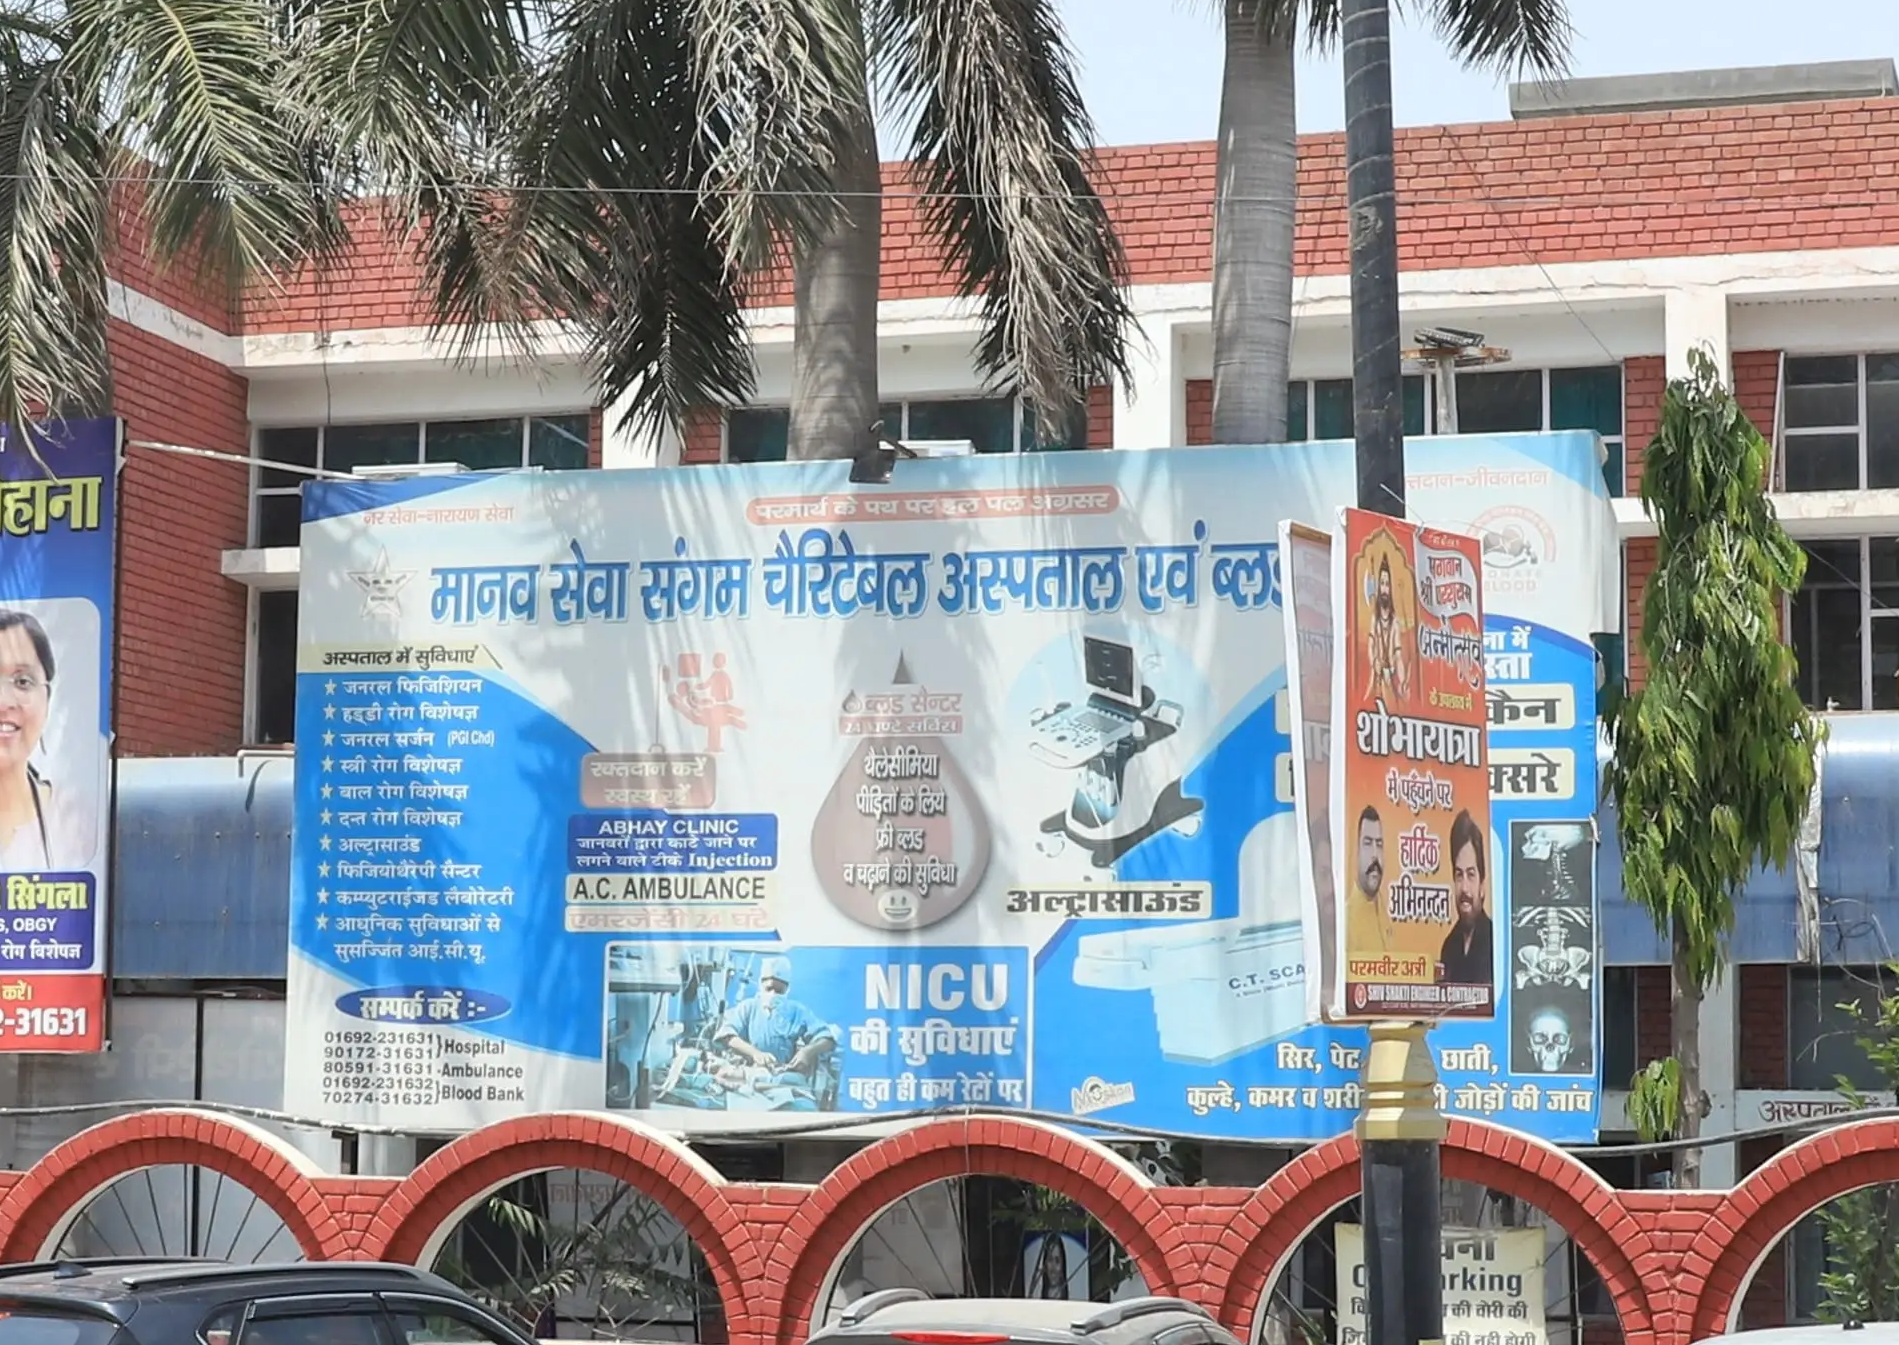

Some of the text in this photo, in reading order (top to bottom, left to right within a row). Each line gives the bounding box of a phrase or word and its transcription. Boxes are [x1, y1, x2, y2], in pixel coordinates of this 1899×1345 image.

[430, 519, 1206, 624] मानव सेवा संगम चैरिटेबल अस्पताल एवं
[323, 642, 479, 671] अस्पताल में सुविधाएं
[342, 675, 483, 695] जनरल फिजिशियन
[388, 702, 479, 723] रोग विशेषज्ञ
[341, 727, 435, 747] जनरल सर्जन
[1357, 700, 1480, 767] शोभायात्रा
[339, 755, 463, 775] स्त्री रोग विशेषज्ञ
[339, 780, 469, 802] बाल रोग विशेषज्ञ
[1438, 779, 1453, 807] पर
[338, 807, 463, 828] दन्त रोग विशेषज्ञ
[599, 820, 739, 835] ABHAY CLINIC
[576, 833, 757, 851] जानवरों द्वारा काटे जाने पर
[1399, 823, 1441, 872] हार्दिक
[576, 852, 773, 870] लगने वाले टीके Injection
[7, 874, 88, 911] सिंगला
[573, 877, 766, 899] A.C. AMBULANCE
[1389, 873, 1452, 923] अभिनन्दन
[13, 917, 57, 933] OBGY
[336, 912, 501, 936] आधुनिक सुविधाओं से
[1349, 956, 1426, 977] परमवीर अत्री
[865, 963, 1009, 1011] NICU
[324, 1031, 434, 1044] 01692-231631
[849, 1016, 1020, 1067] की सुविधाएं
[324, 1047, 433, 1059] 90172-31631
[444, 1040, 505, 1058] Hospital
[323, 1062, 432, 1074] 80591-31631
[1440, 1046, 1499, 1076] छाती,
[323, 1077, 433, 1089] 01692-231632
[442, 1086, 525, 1101] Blood Bank
[849, 1072, 1025, 1109] बहुत ही कम रेटों पर
[323, 1092, 433, 1105] 70274-31632
[1248, 1088, 1298, 1110] कमर
[1302, 1089, 1317, 1109] व
[1511, 1083, 1541, 1112] की
[1545, 1085, 1594, 1113] जांच
[1442, 1267, 1521, 1297] rking
